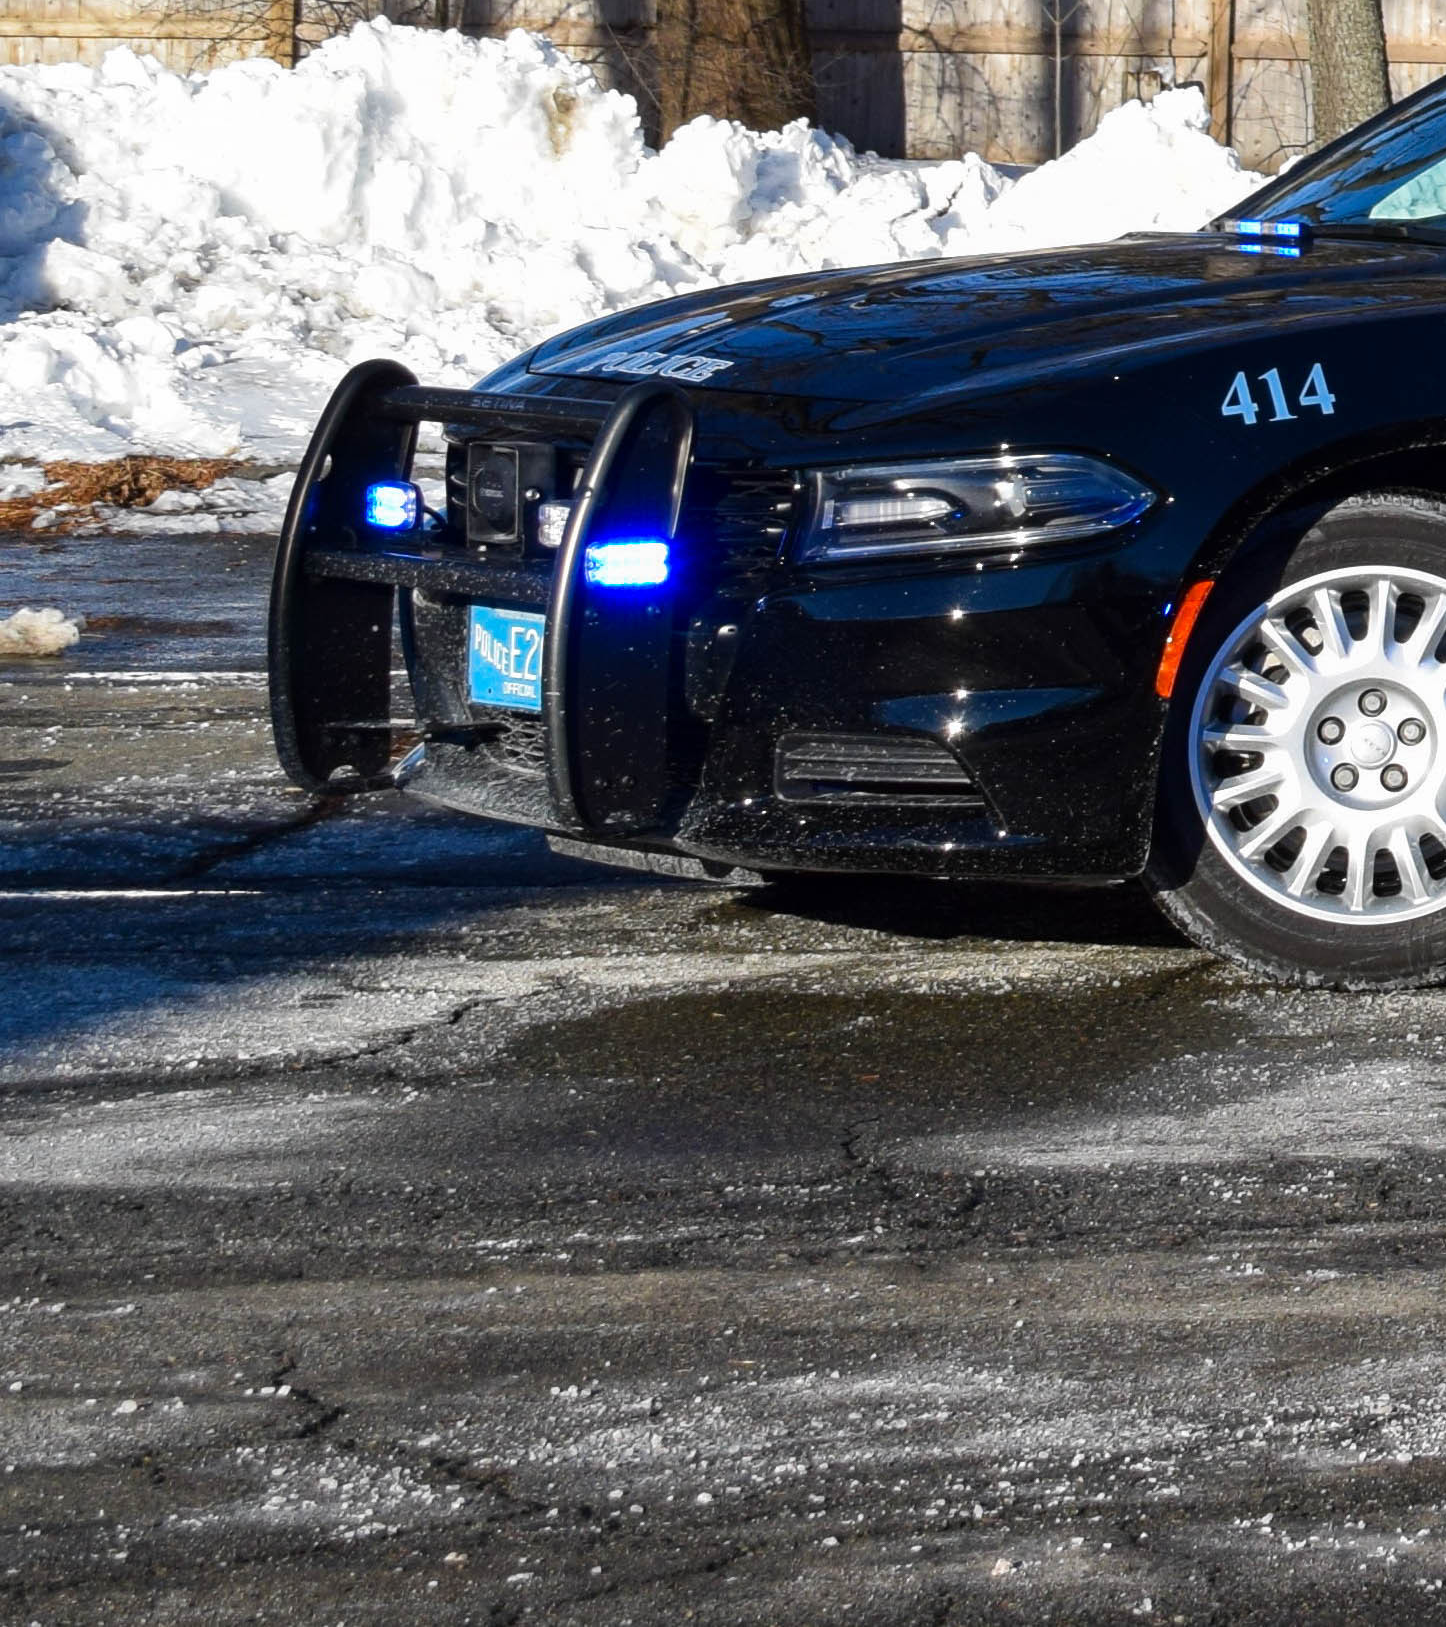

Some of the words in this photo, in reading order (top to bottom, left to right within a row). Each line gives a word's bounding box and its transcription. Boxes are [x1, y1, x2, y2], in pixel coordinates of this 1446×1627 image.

[576, 352, 735, 382] POLICE
[1222, 362, 1336, 425] 414
[475, 624, 509, 675] POLICE
[510, 627, 544, 680] E2
